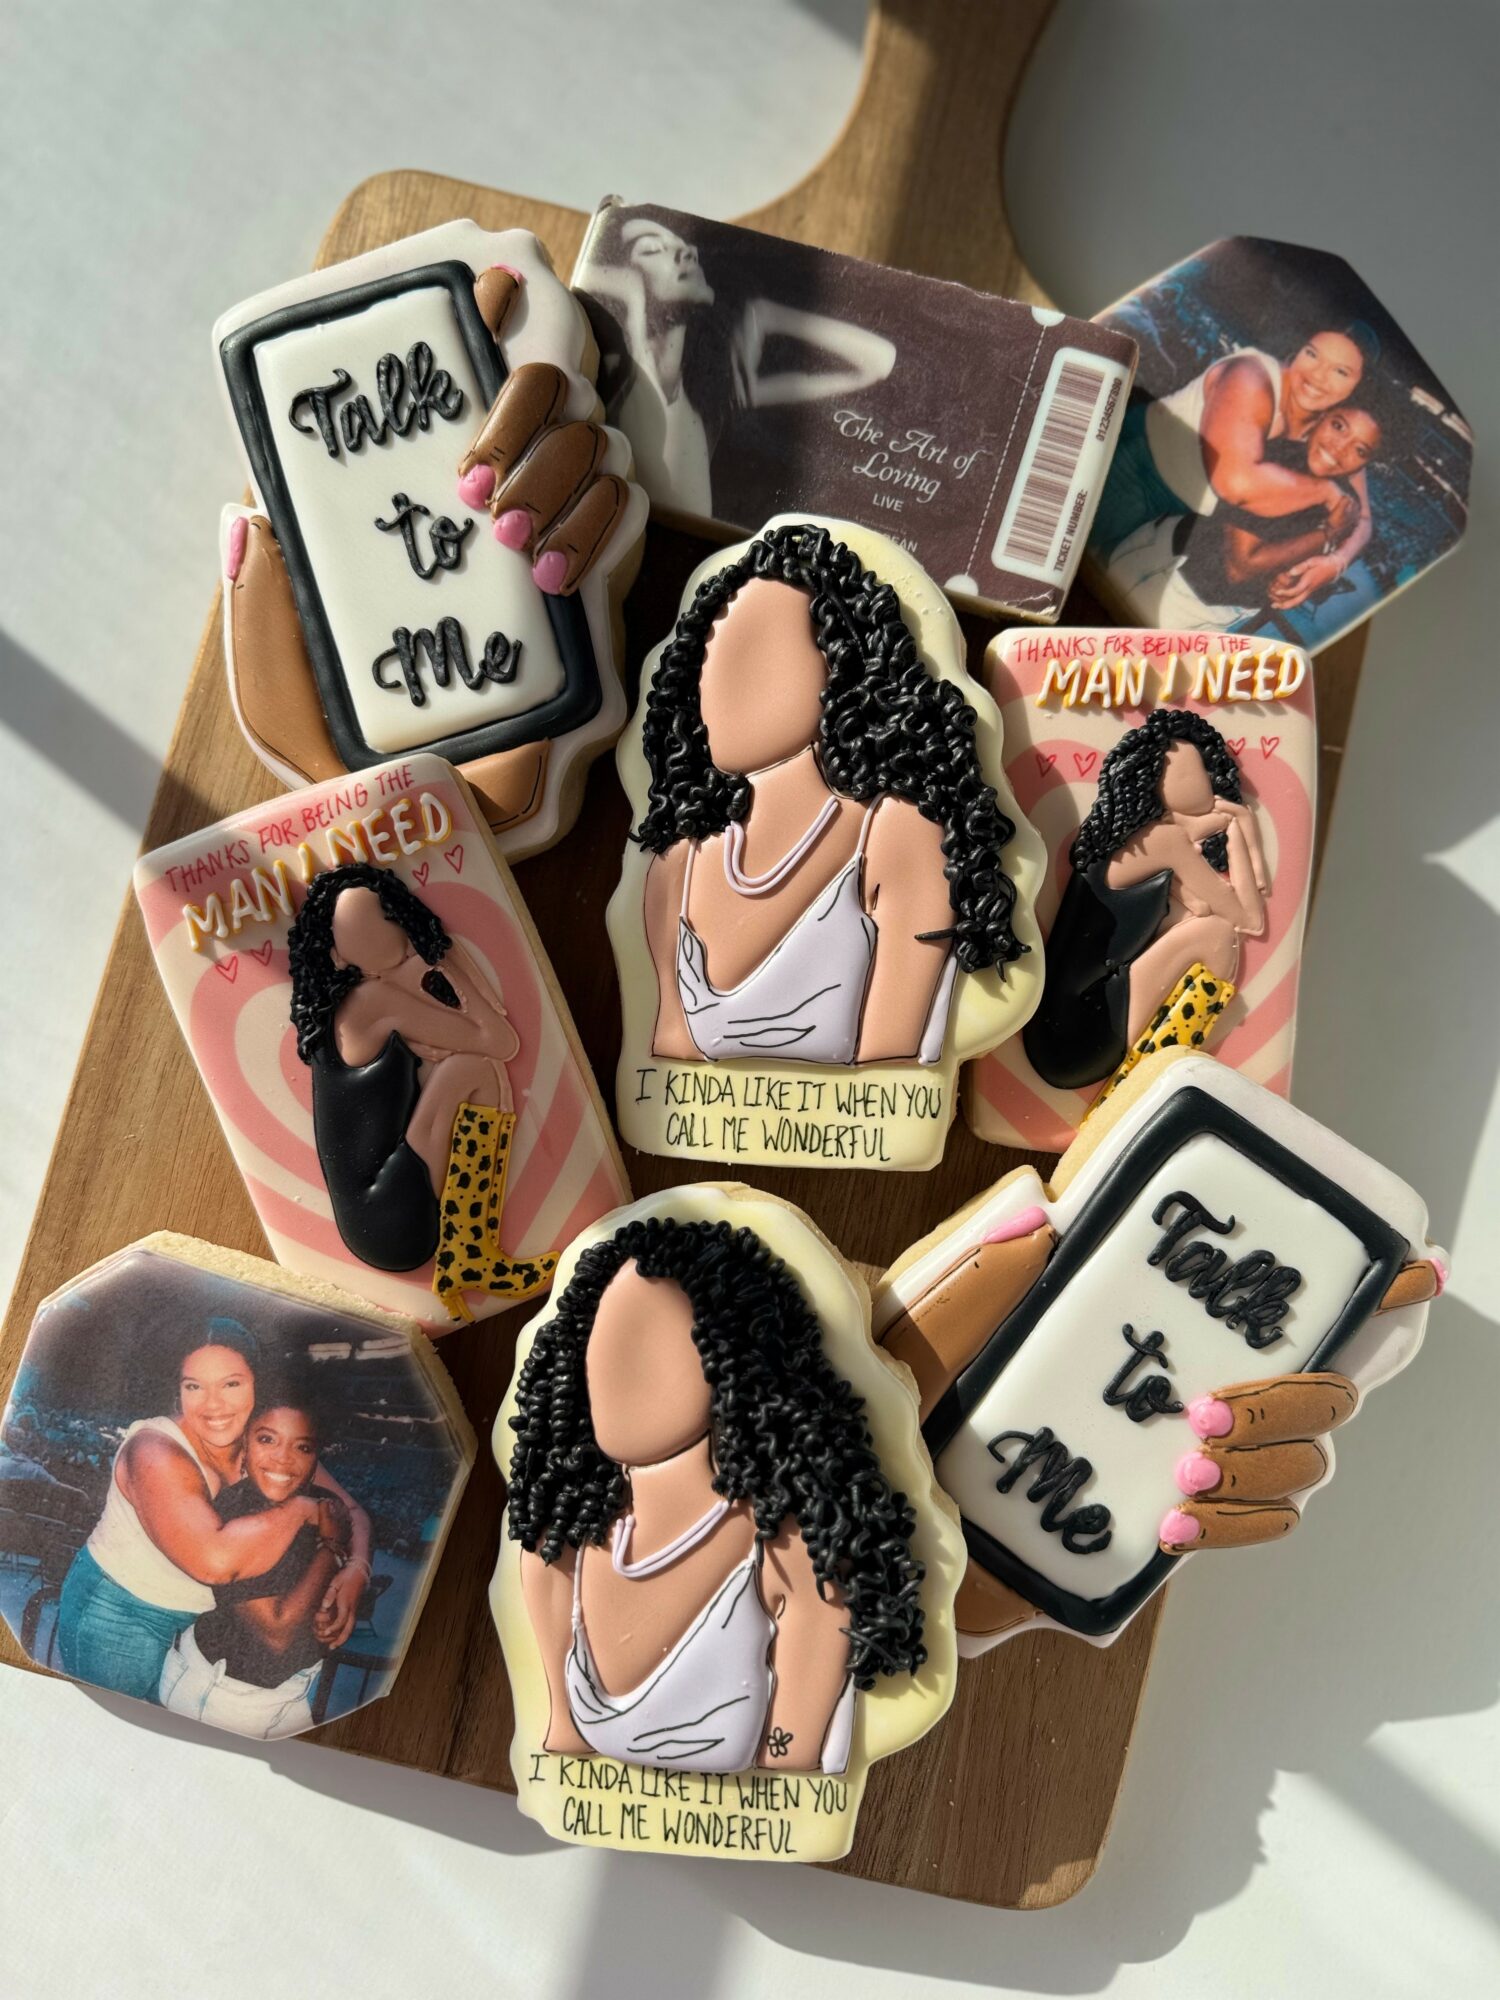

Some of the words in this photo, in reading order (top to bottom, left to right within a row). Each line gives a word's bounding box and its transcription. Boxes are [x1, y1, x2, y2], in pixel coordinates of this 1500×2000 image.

[288, 341, 464, 458] Talk
[1096, 377, 1123, 442] 01234567890
[834, 410, 883, 445] The
[889, 430, 949, 464] Art
[953, 449, 994, 479] of
[852, 452, 941, 503] Loving
[375, 492, 473, 580] to
[872, 493, 904, 512] LIVE
[1053, 540, 1074, 572] TICKET
[1066, 489, 1088, 536] NUMBER:
[372, 616, 524, 708] Me
[1013, 635, 1097, 663] THANKS
[1104, 634, 1135, 656] FOR
[1142, 634, 1209, 656] BEING
[1217, 635, 1251, 655] THE
[1035, 657, 1149, 709] MAN
[1159, 653, 1179, 702] I
[1191, 643, 1307, 703] NEED
[165, 839, 250, 893] THANKS
[258, 818, 299, 854] FOR
[300, 783, 369, 833] BEING
[375, 764, 415, 797] THE
[182, 858, 296, 951] MAN
[297, 841, 316, 884] I
[325, 792, 452, 867] NEED
[635, 1068, 657, 1101] I
[665, 1070, 736, 1107] KINDA
[743, 1076, 792, 1112] LIKE
[797, 1080, 827, 1112] IT
[835, 1082, 897, 1118] WHEN
[902, 1083, 942, 1119] YOU
[666, 1112, 714, 1149] CALL
[722, 1116, 749, 1152] ME
[761, 1115, 891, 1162] WONDERFUL
[1147, 1190, 1302, 1349] Talk
[1102, 1323, 1185, 1423] to
[986, 1425, 1115, 1555] Me
[529, 1753, 550, 1782] I
[560, 1758, 633, 1795] KINDA
[640, 1766, 691, 1802] LIKE
[699, 1772, 730, 1805] IT
[736, 1775, 800, 1812] WHEN
[806, 1778, 848, 1815] YOU
[563, 1796, 612, 1836] CALL
[620, 1804, 650, 1840] ME
[663, 1808, 797, 1854] WONDERFUL
